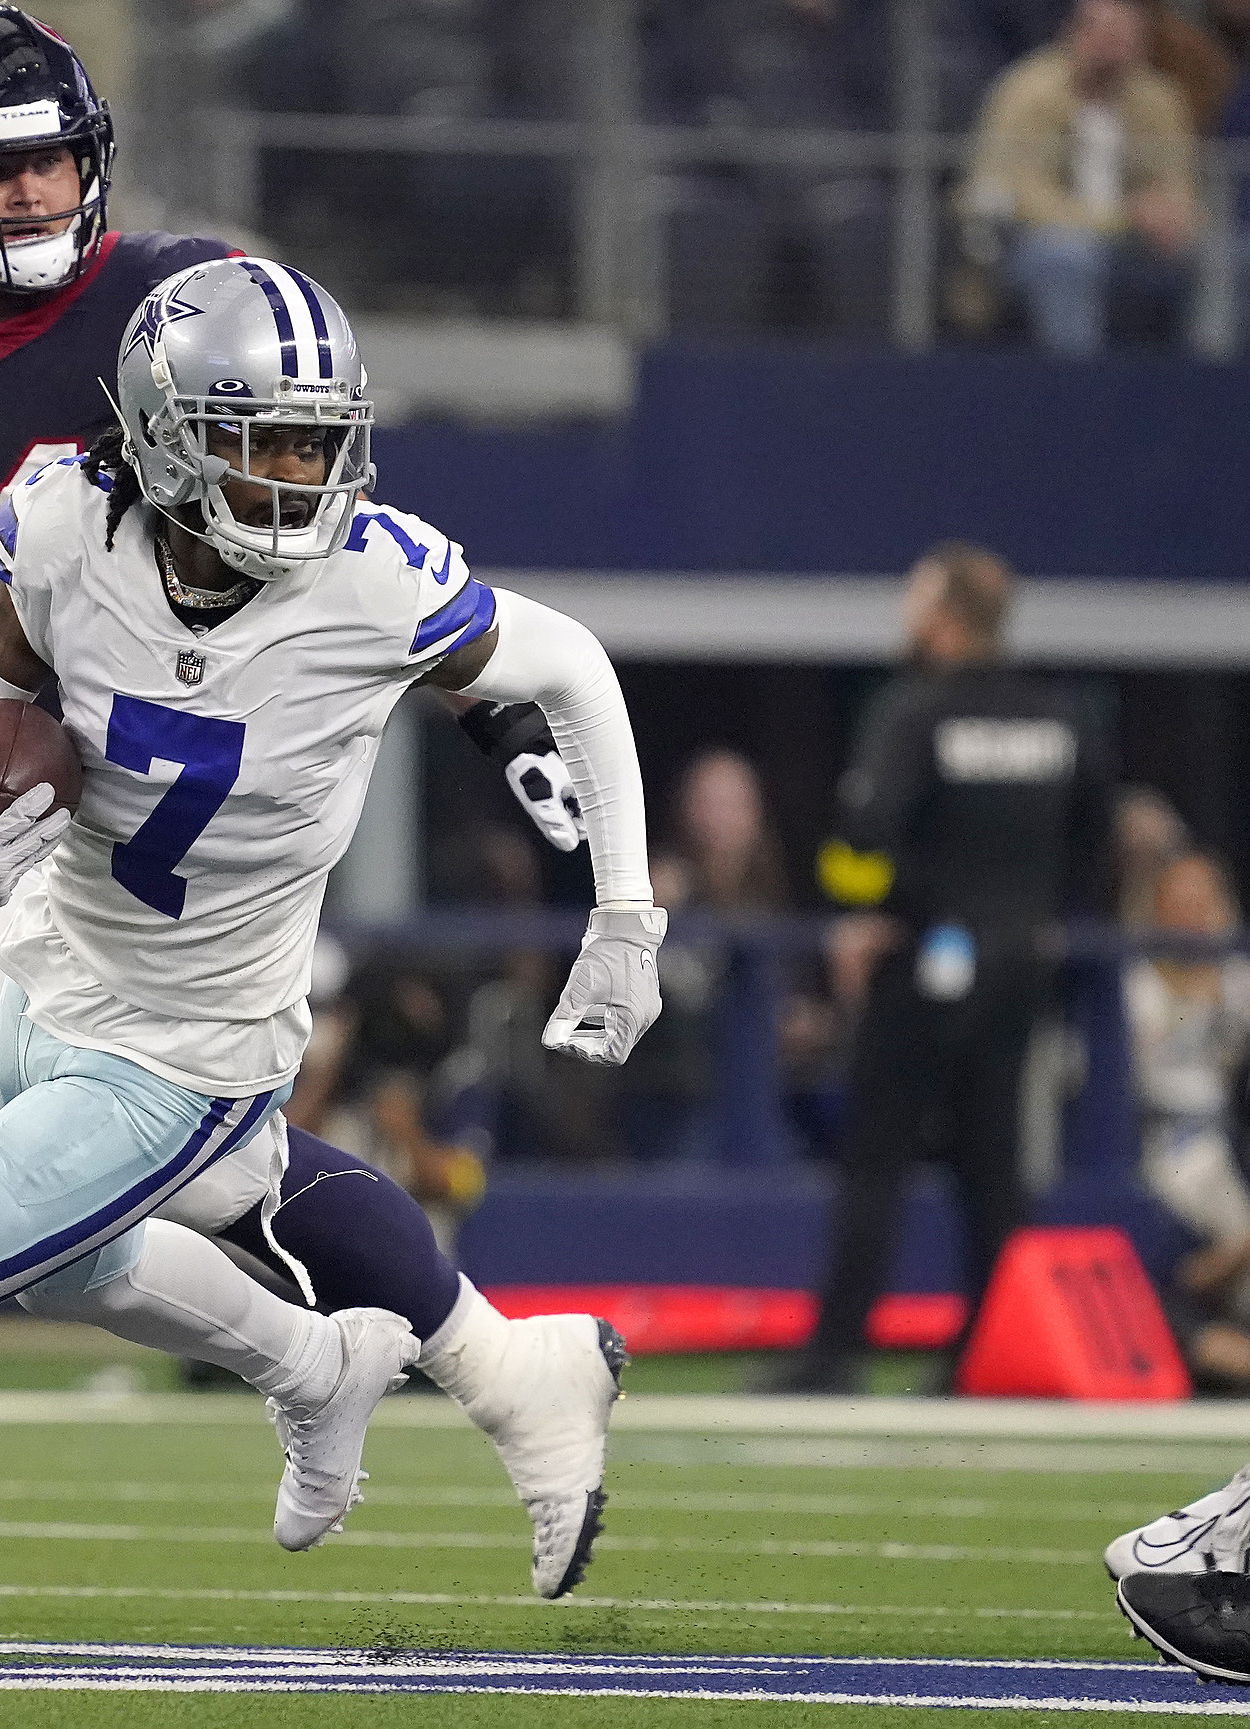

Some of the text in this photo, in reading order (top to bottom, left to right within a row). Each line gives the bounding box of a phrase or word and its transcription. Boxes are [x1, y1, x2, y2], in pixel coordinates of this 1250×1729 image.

[343, 512, 430, 570] 7
[179, 664, 200, 681] NFL
[104, 692, 246, 921] 7
